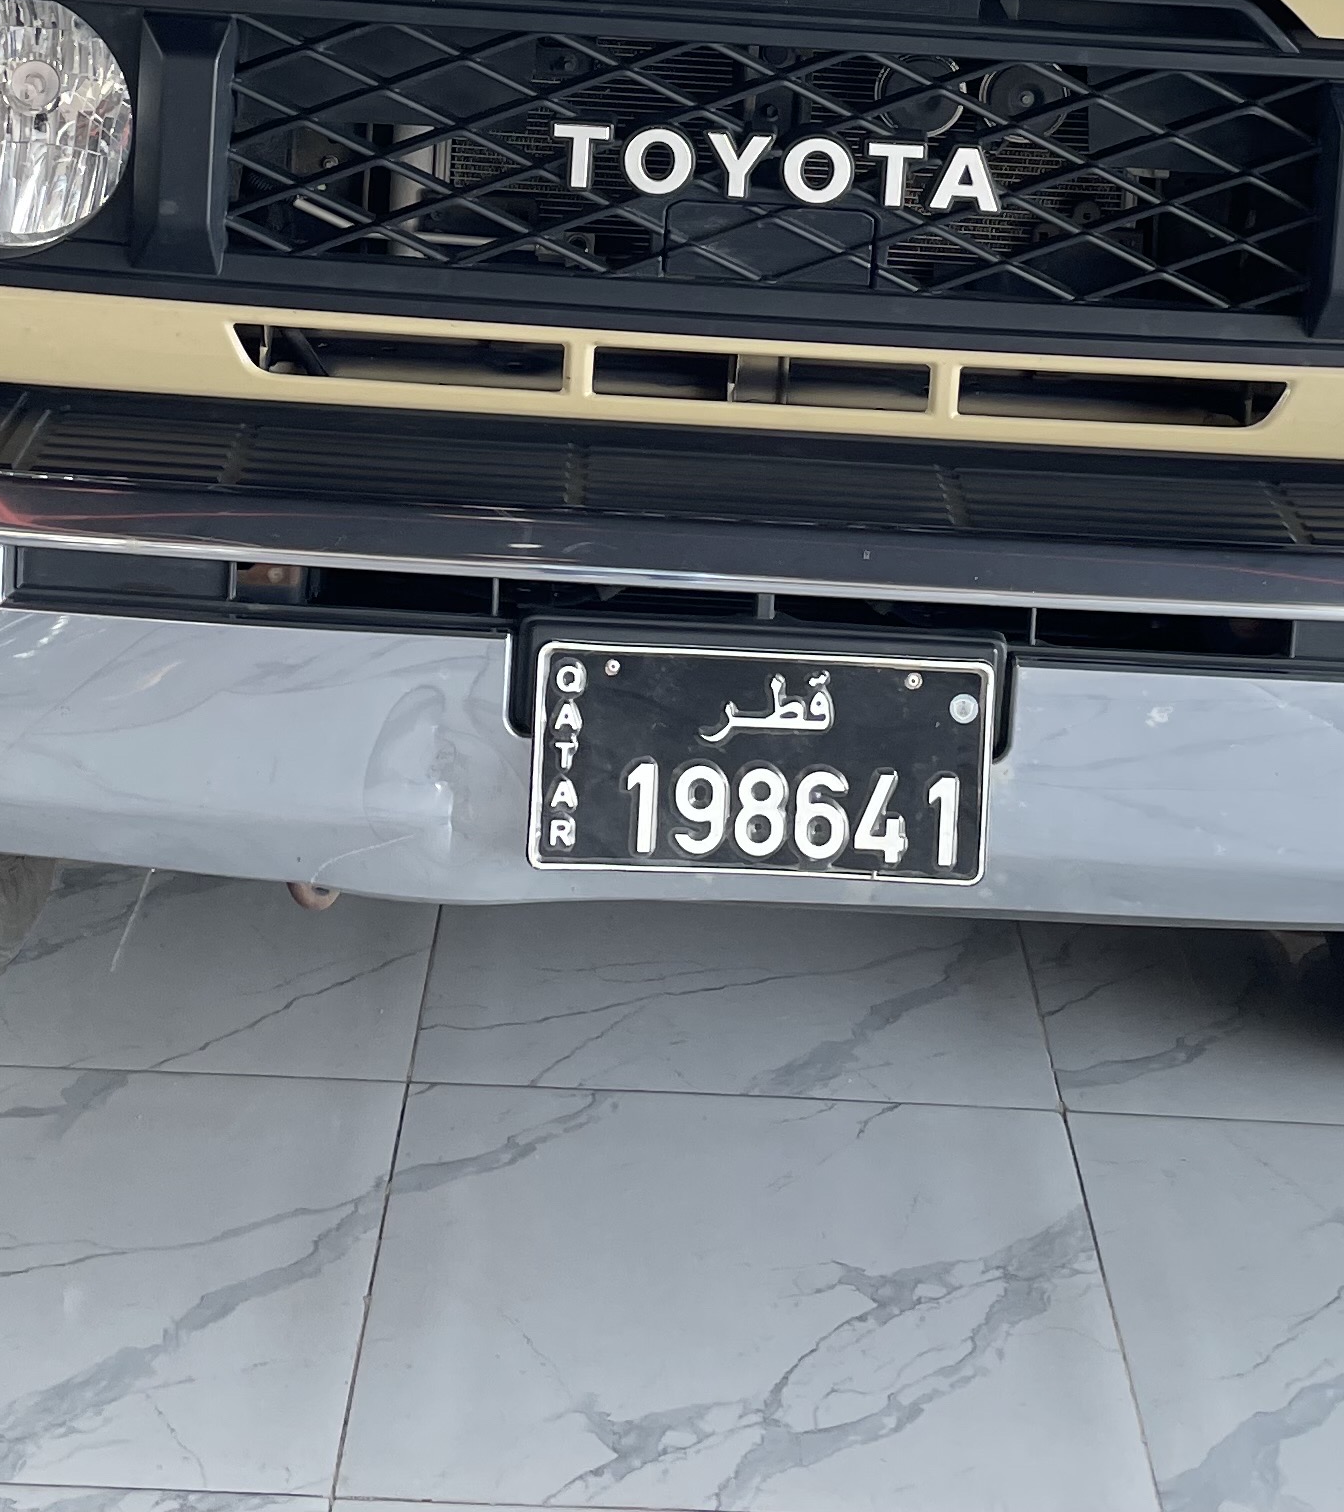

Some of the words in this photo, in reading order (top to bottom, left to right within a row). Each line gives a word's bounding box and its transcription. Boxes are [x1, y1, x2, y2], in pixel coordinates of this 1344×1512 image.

[552, 122, 1001, 214] TOYOTA
[548, 663, 587, 848] QATAR
[698, 670, 836, 742] قطر
[625, 760, 961, 868] 198641
